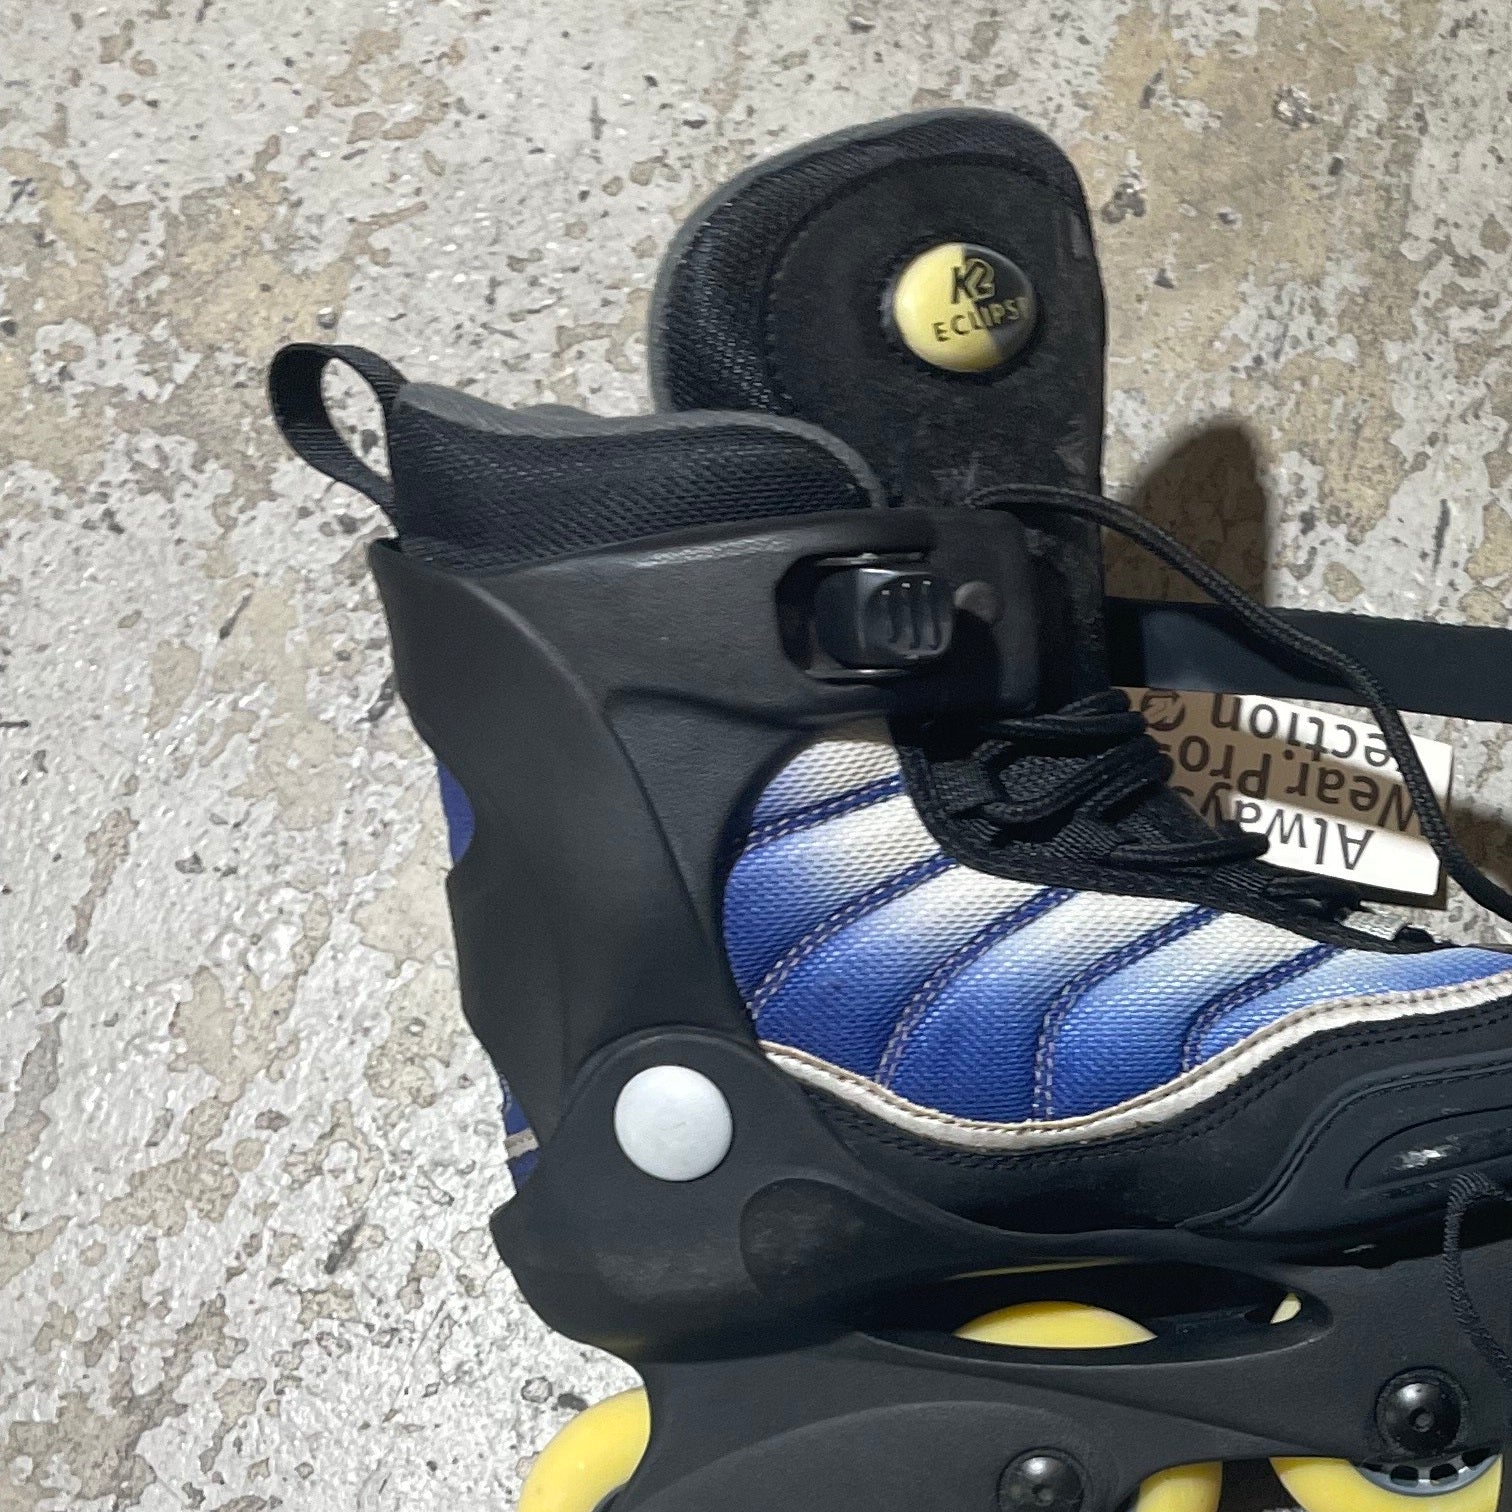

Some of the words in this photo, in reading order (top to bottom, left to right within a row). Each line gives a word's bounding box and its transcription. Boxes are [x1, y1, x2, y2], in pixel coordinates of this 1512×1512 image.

[952, 258, 995, 305] K2
[1212, 692, 1396, 768] ection
[1174, 781, 1375, 871] Alway
